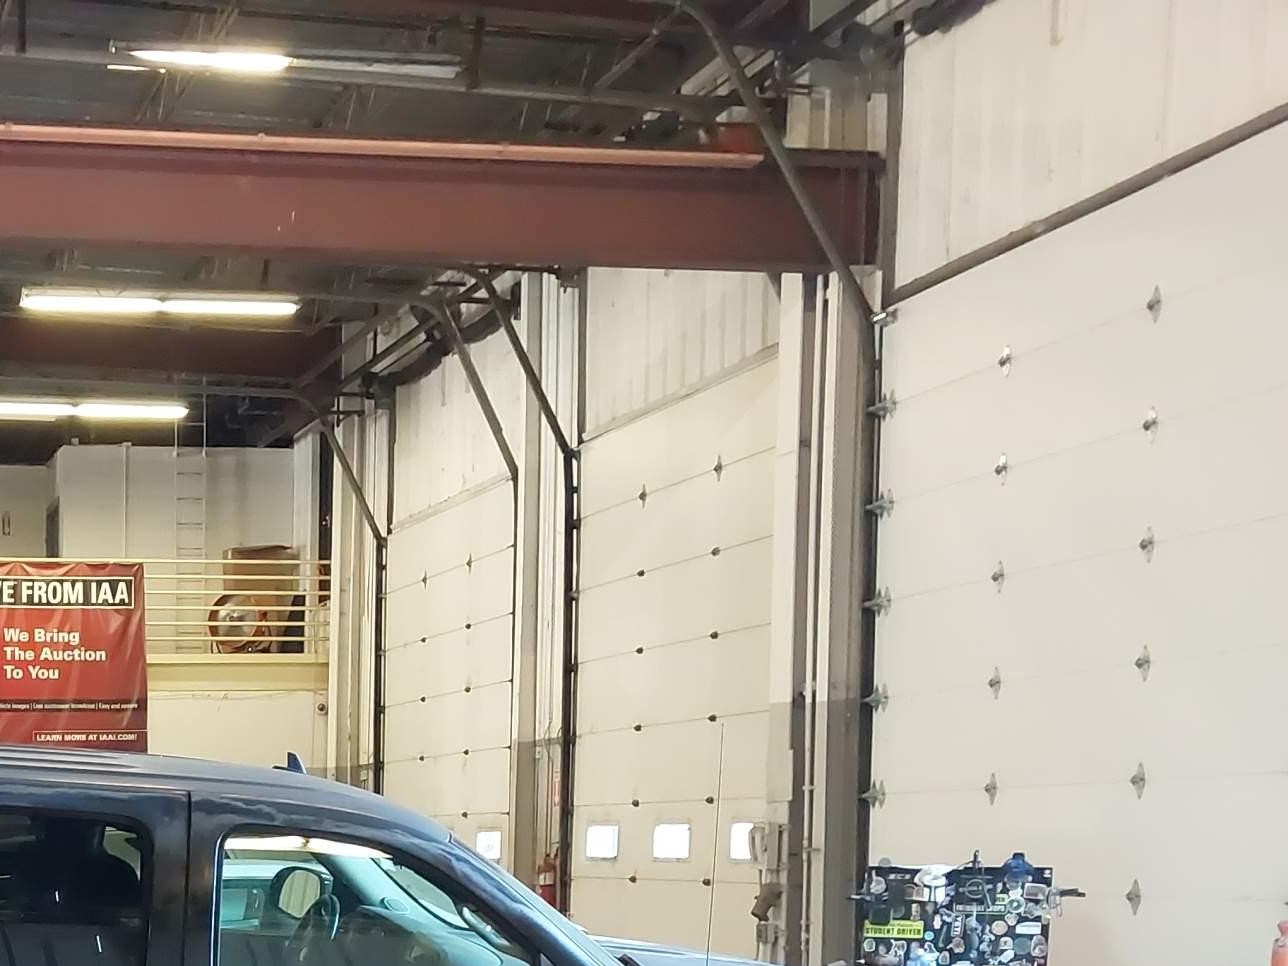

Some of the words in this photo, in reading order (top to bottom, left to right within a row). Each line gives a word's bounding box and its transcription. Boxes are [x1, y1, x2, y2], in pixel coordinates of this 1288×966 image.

[21, 581, 84, 604] FROM
[90, 581, 129, 604] IAA
[3, 628, 29, 643] We
[34, 628, 80, 646] Bring
[3, 647, 35, 661] The
[40, 647, 106, 662] Auction
[3, 665, 23, 680] To
[28, 665, 59, 680] You
[865, 927, 895, 936] STUDENT
[896, 928, 922, 936] DRIVER
